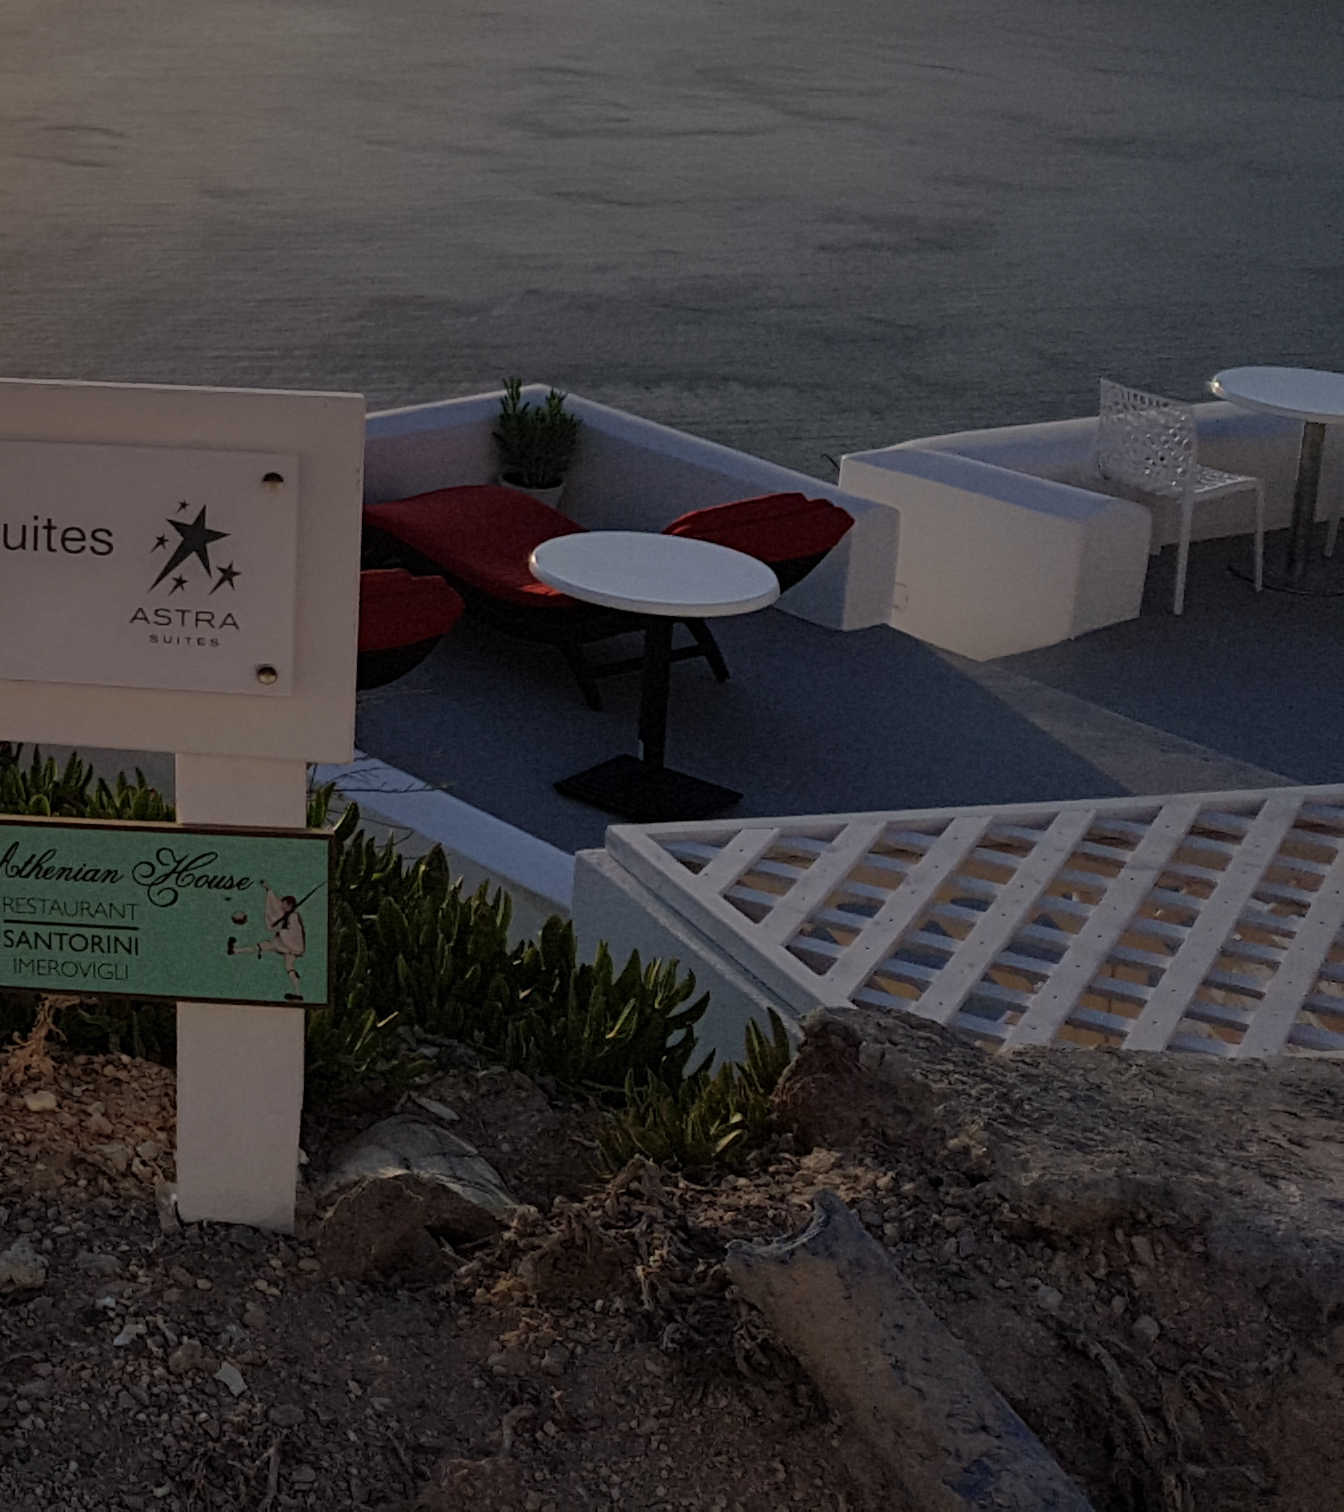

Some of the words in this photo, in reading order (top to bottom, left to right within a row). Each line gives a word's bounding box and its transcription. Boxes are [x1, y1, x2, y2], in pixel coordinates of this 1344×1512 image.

[128, 607, 241, 631] ASTRA
[149, 633, 221, 648] SUITES
[131, 846, 256, 908] House
[2, 896, 140, 922] RESTAURANT
[2, 929, 141, 957] SANTORINI
[12, 957, 130, 982] IMEROVIGLI
